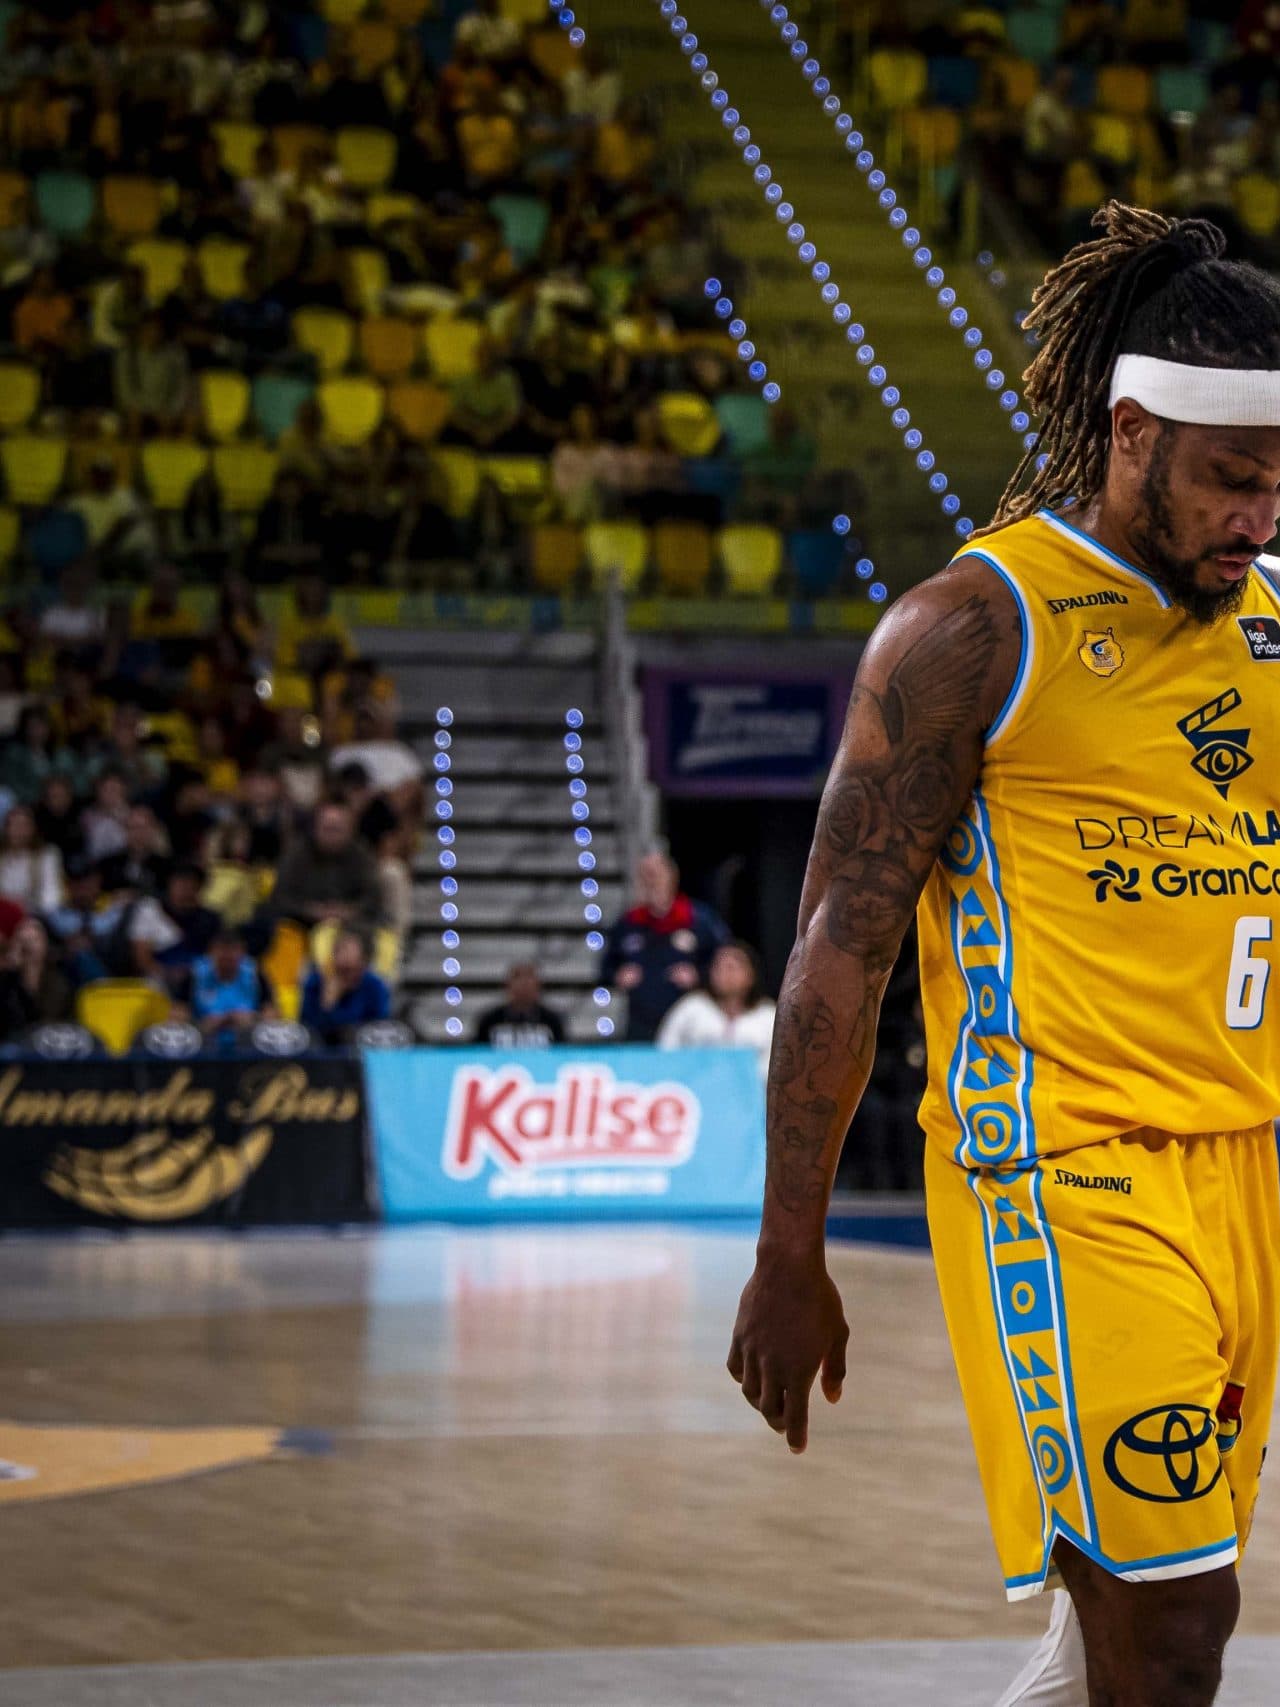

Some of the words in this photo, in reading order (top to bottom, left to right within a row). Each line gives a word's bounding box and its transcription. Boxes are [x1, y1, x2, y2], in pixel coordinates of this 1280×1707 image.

[1046, 590, 1128, 614] SPALDING
[1247, 629, 1267, 643] liga
[1226, 916, 1272, 1030] 6
[452, 1075, 690, 1166] Kalise
[1054, 1168, 1132, 1195] SPALDING
